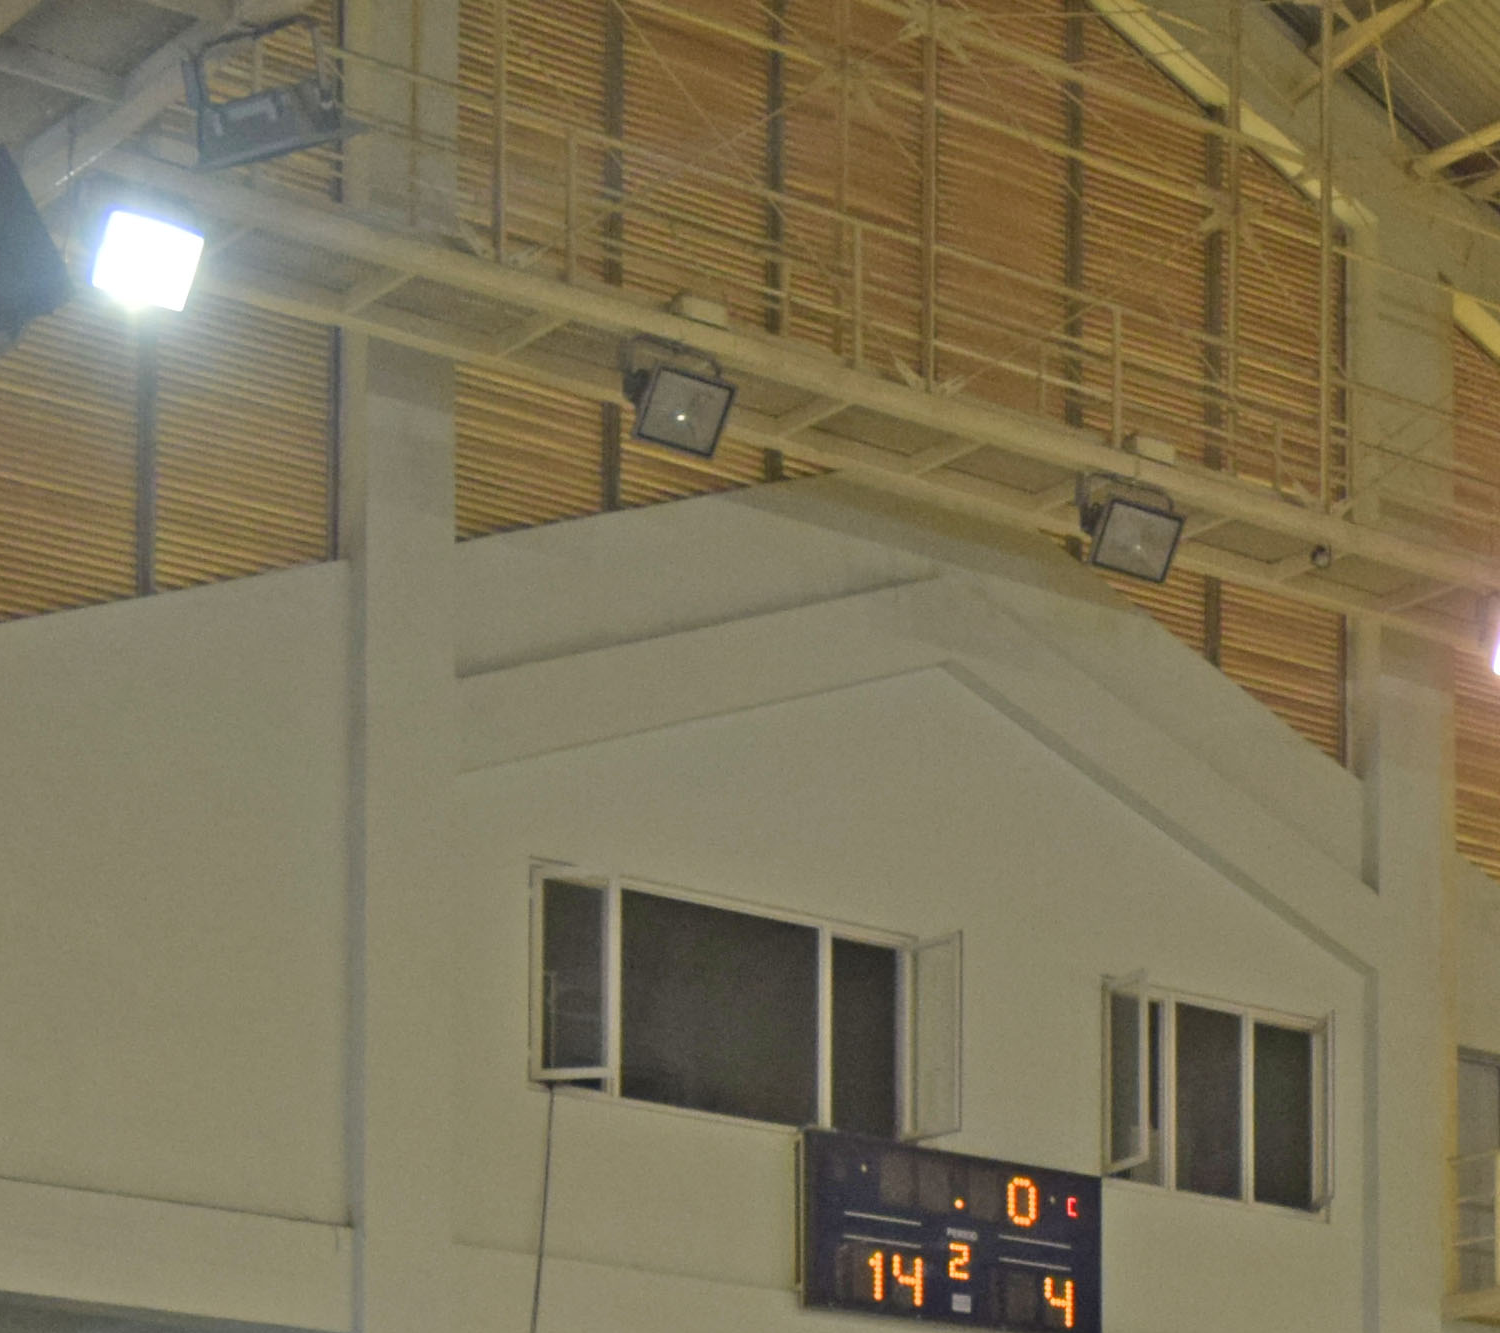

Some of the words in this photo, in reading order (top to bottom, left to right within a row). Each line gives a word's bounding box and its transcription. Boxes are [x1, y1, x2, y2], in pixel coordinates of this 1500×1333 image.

[868, 1251, 924, 1307] 14
[948, 1242, 971, 1281] 2
[1043, 1276, 1075, 1329] 4
